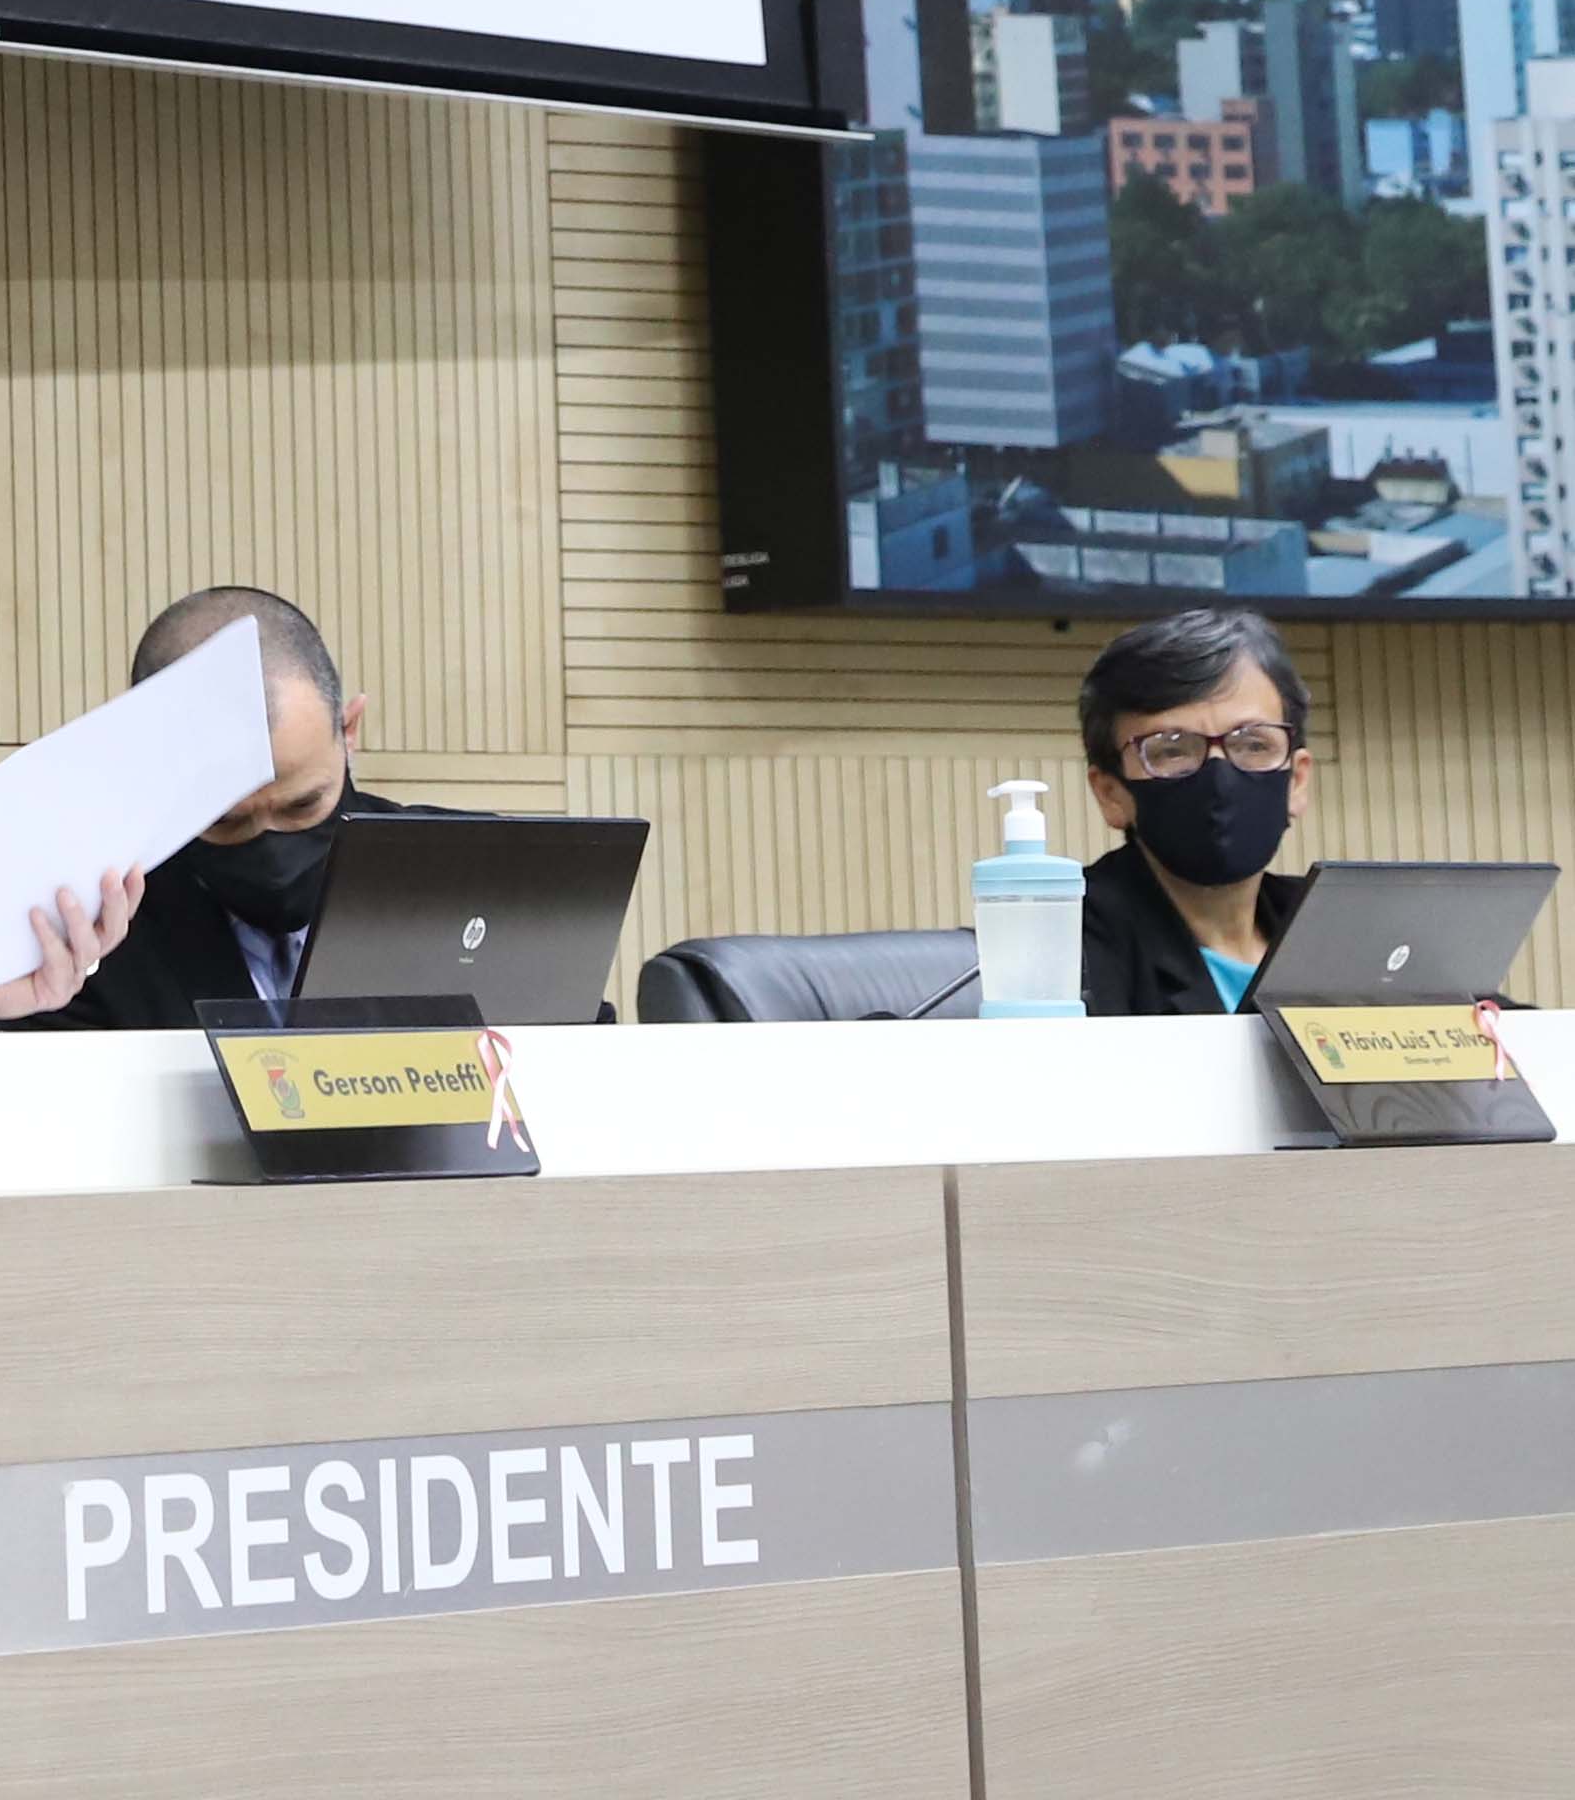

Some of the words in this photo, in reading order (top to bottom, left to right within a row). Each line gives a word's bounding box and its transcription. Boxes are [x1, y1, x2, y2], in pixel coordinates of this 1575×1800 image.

[312, 1068, 403, 1098] Gerson
[404, 1062, 486, 1095] Peteffi
[64, 1433, 760, 1622] PRESIDENTE
